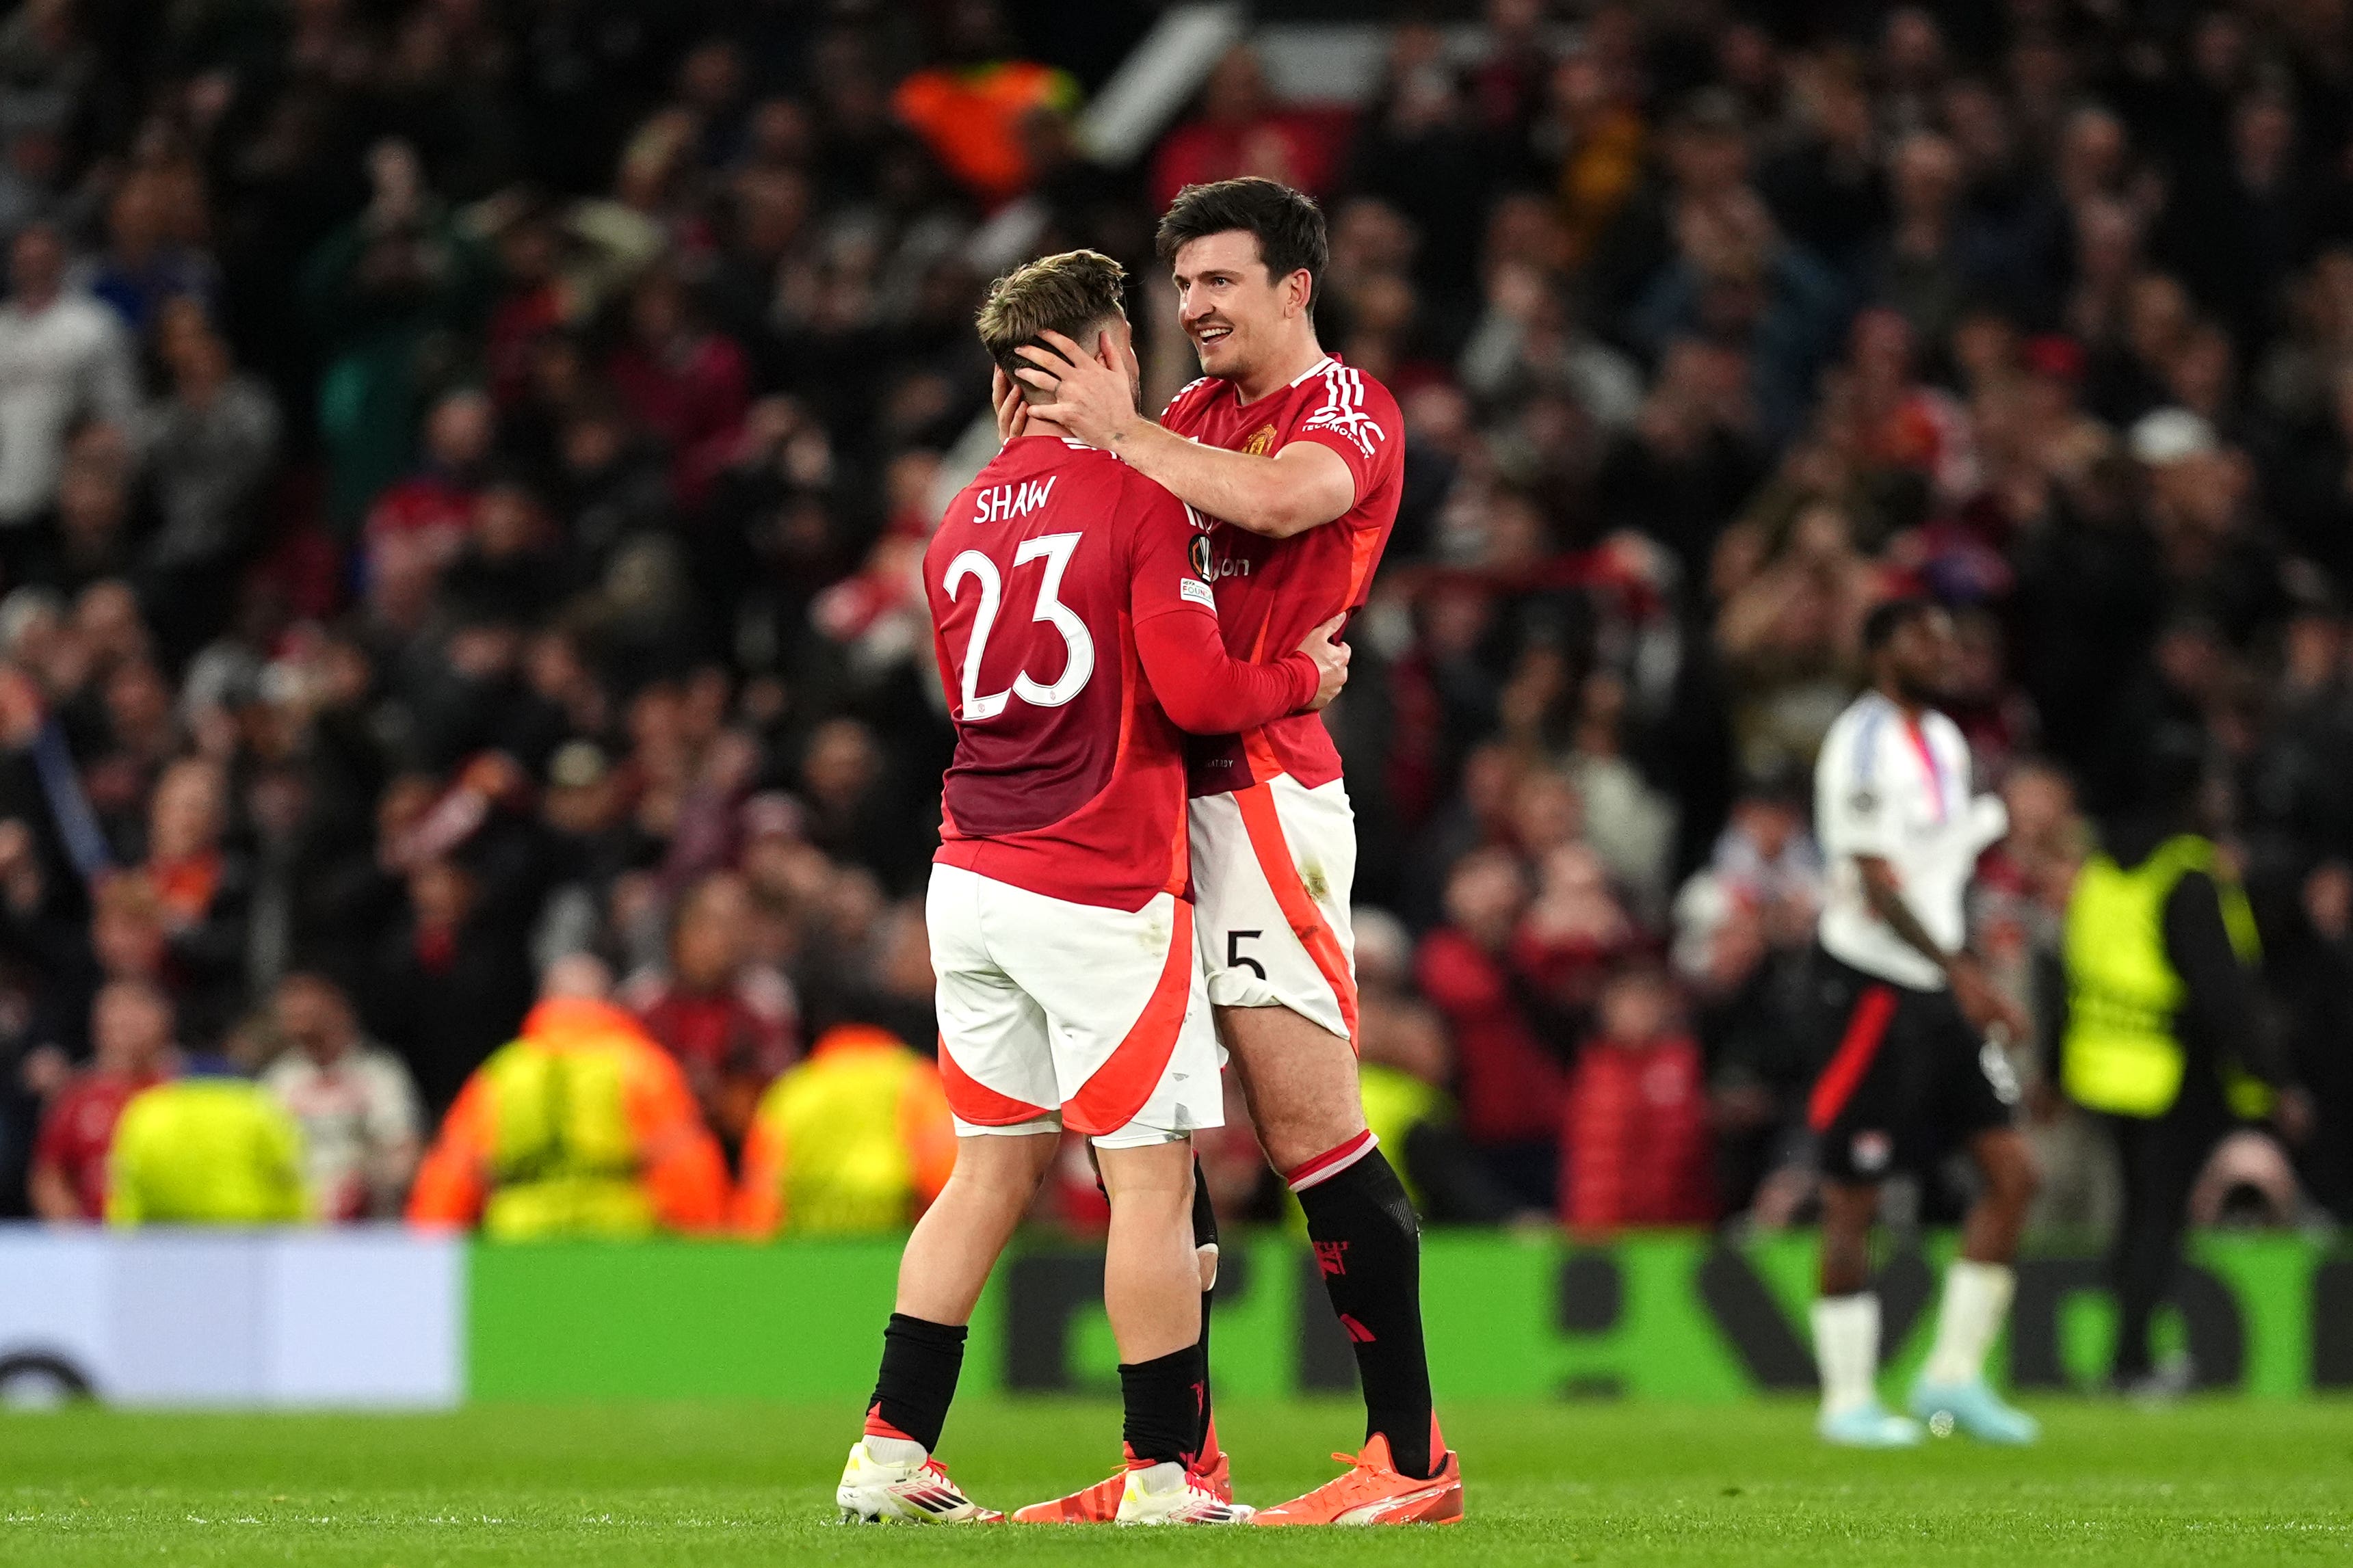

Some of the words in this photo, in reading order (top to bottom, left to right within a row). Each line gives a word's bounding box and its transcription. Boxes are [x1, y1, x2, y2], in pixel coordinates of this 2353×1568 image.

[973, 475, 1057, 524] SHAW
[943, 531, 1094, 721] 23
[1227, 930, 1266, 981] 5
